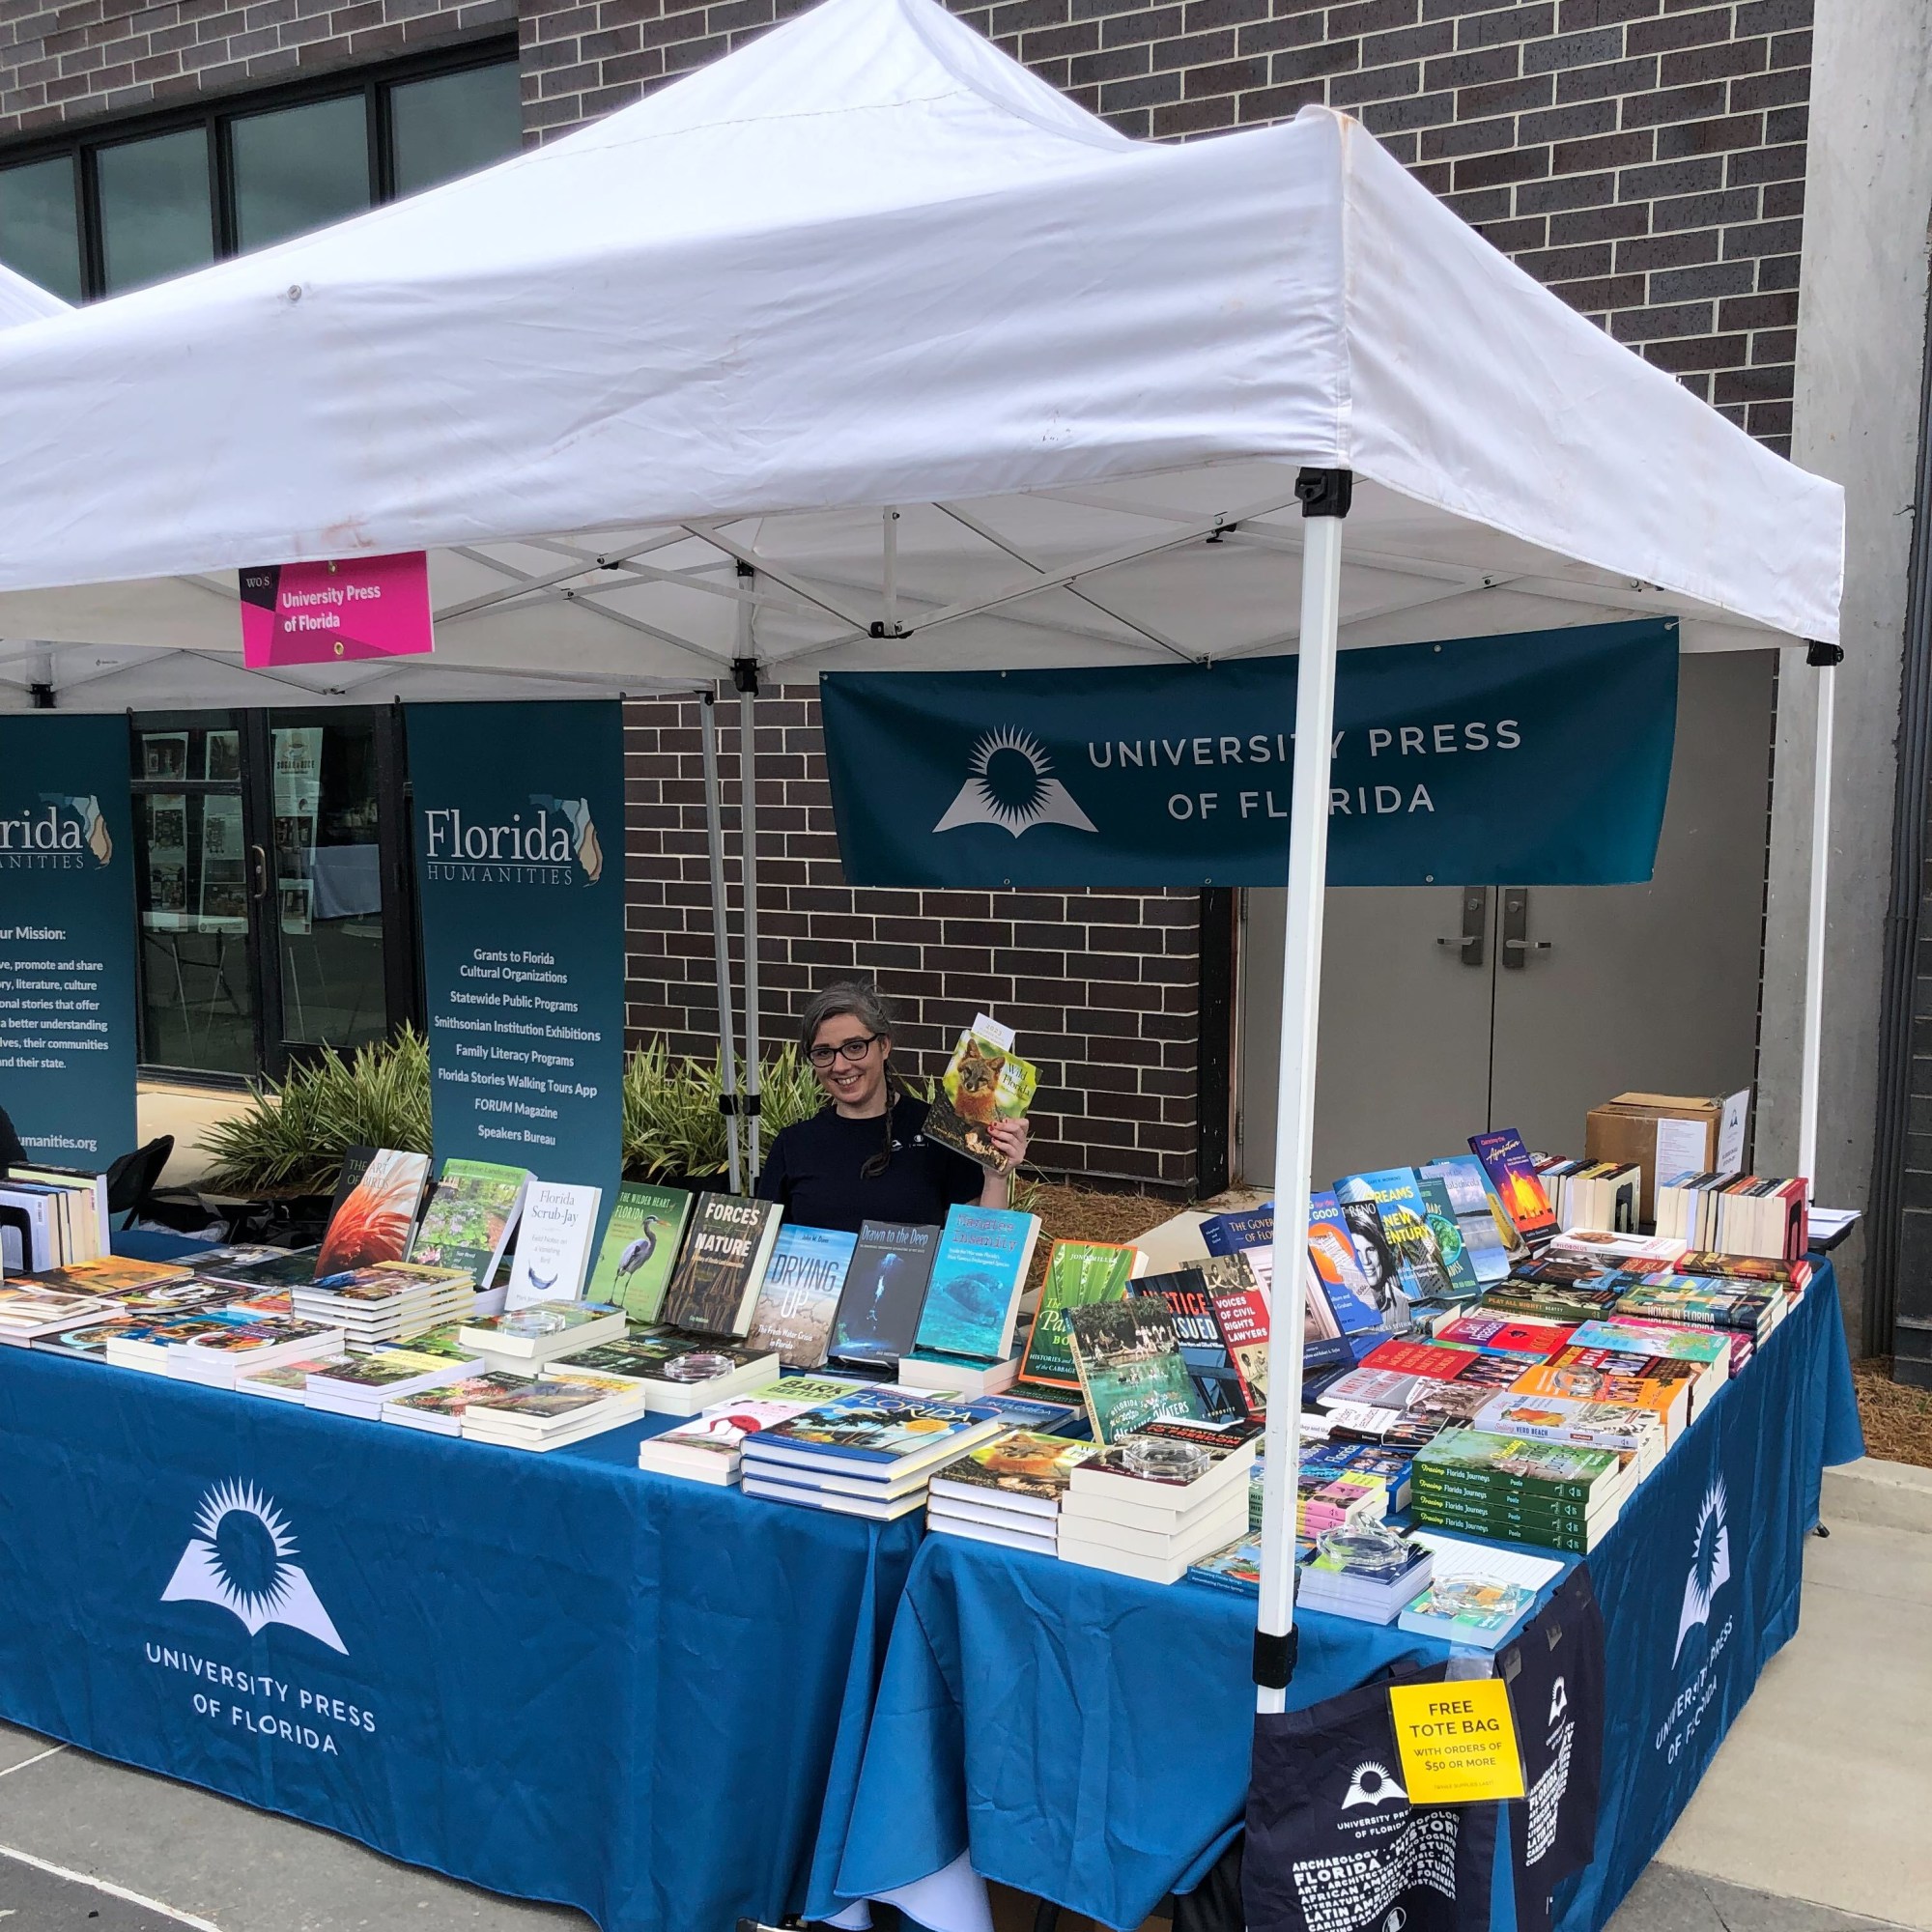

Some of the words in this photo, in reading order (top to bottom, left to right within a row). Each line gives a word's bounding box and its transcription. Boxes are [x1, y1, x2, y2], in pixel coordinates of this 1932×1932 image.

[282, 588, 344, 609] University
[347, 585, 382, 601] Press
[284, 619, 298, 633] of
[299, 611, 341, 631] Florida
[1088, 730, 1346, 769] UNIVERSIY
[1369, 719, 1521, 756] PRESS
[1168, 793, 1218, 819] OF
[1239, 783, 1435, 819] FLRIDA
[425, 809, 572, 861] Florida
[428, 865, 573, 886] HUMANITIES
[15, 925, 67, 940] Mission:
[14, 961, 56, 972] promote
[58, 960, 74, 970] and
[76, 960, 103, 971] share
[473, 949, 508, 962] Grants
[510, 951, 522, 963] to
[523, 952, 554, 965] Florida
[461, 965, 500, 980] Cultural
[502, 967, 568, 983] Organizations
[15, 979, 63, 991] literature,
[64, 980, 98, 990] culture
[21, 999, 53, 1009] stories
[55, 999, 74, 1009] that
[75, 1000, 100, 1010] offer
[450, 991, 500, 1006] Statewide
[502, 994, 533, 1009] Public
[534, 998, 579, 1012] Programs
[0, 1019, 6, 1028] a
[9, 1018, 39, 1029] better
[41, 1019, 108, 1032] understanding
[435, 1015, 492, 1032] Smithsonian
[494, 1020, 545, 1037] Institution
[546, 1027, 601, 1042] Exhibitions
[23, 1037, 46, 1048] their
[47, 1039, 109, 1050] communities
[16, 1057, 39, 1067] their
[41, 1058, 67, 1068] state.
[456, 1044, 489, 1061] Family
[491, 1046, 530, 1064] Literacy
[531, 1051, 575, 1067] Programs
[1007, 1062, 1029, 1081] Wild
[438, 1068, 469, 1083] Florida
[470, 1071, 505, 1087] Stories
[506, 1075, 547, 1093] Walking
[548, 1080, 573, 1094] Tours
[574, 1083, 598, 1099] App
[1002, 1074, 1031, 1096] Florida
[474, 1097, 513, 1112] FORUM
[514, 1102, 558, 1120] Magazine
[477, 1124, 523, 1141] Speakers
[524, 1131, 556, 1147] Bureau
[349, 1159, 367, 1172] THE
[368, 1161, 389, 1174] ART
[347, 1174, 360, 1185] OF
[362, 1177, 390, 1190] BIRDS
[539, 1190, 575, 1206] Florida
[619, 1192, 631, 1203] THE
[631, 1193, 652, 1207] WILDER
[652, 1196, 671, 1208] HEART
[531, 1206, 579, 1227] Scrub-Jay
[614, 1205, 644, 1221] FLORIDA
[705, 1202, 760, 1226] FORCES
[1312, 1208, 1339, 1221] GOOD
[1350, 1203, 1377, 1217] RENO
[957, 1214, 1015, 1232] Manatee
[1229, 1221, 1247, 1233] THE
[1383, 1212, 1411, 1227] NEW
[862, 1225, 886, 1242] Drawn
[887, 1228, 895, 1242] to
[896, 1228, 908, 1243] the
[909, 1229, 929, 1246] Deep
[952, 1230, 1018, 1253] Insanity
[1245, 1233, 1257, 1242] OF
[695, 1233, 753, 1257] NATURE
[1556, 1242, 1587, 1252] PILOBOLUS
[771, 1254, 839, 1293] DRYING
[781, 1290, 810, 1319] UP
[1046, 1297, 1062, 1309] The
[1216, 1295, 1247, 1309] VOICES
[1489, 1297, 1505, 1306] PLAY
[1519, 1301, 1543, 1311] NIGHT!
[1220, 1310, 1232, 1321] OF
[1233, 1308, 1256, 1319] CIVIL
[1647, 1305, 1671, 1319] HOME
[1672, 1308, 1681, 1320] IN
[1683, 1310, 1716, 1323] FLORIDA
[768, 1325, 782, 1336] Fresh
[782, 1328, 798, 1339] Water
[798, 1331, 813, 1342] Crisis
[1224, 1318, 1255, 1332] RIGHTS
[1228, 1327, 1268, 1343] LAWYERS
[776, 1340, 793, 1350] Florida
[1029, 1353, 1062, 1364] HISTORIES
[766, 1386, 837, 1399] BEETLES
[779, 1379, 852, 1395] BARK
[842, 1393, 973, 1422] FLORIDA
[999, 1403, 1052, 1415] FLORIDA
[1153, 1401, 1190, 1420] WATERS
[1170, 1429, 1240, 1445] FREEDOM
[1219, 1432, 1245, 1441] ROW
[1516, 1426, 1529, 1435] VERO
[1531, 1428, 1548, 1436] BEACH
[1421, 1463, 1445, 1475] Tracing
[1446, 1469, 1465, 1479] Florida
[1465, 1470, 1491, 1483] Journeys
[1419, 1479, 1442, 1492] Tracing
[1443, 1484, 1463, 1494] Florida
[1463, 1487, 1488, 1499] Journeys
[1420, 1496, 1443, 1508] Tracing
[1444, 1500, 1463, 1511] Florida
[1463, 1503, 1489, 1516] Journeys
[1420, 1512, 1443, 1524] Tracing
[1445, 1518, 1464, 1527] Florida
[1464, 1520, 1489, 1533] Journeys
[146, 1642, 289, 1702] UNIVERSITY
[299, 1689, 376, 1732] PRESS
[1429, 1700, 1474, 1716] FREE
[193, 1693, 221, 1718] OF
[232, 1706, 338, 1756] FLORIDA
[1409, 1721, 1458, 1738] TOTE
[1462, 1718, 1500, 1734] BAG
[1414, 1747, 1442, 1757] WITH
[1444, 1743, 1486, 1755] ORDERS
[1489, 1742, 1502, 1750] OF
[1667, 1733, 1682, 1765] OF
[1425, 1760, 1446, 1772] $50
[1448, 1760, 1463, 1769] OR
[1465, 1757, 1496, 1768] MORE
[1337, 1814, 1391, 1831] UNIVERSITY
[1354, 1830, 1368, 1839] OF
[1370, 1820, 1406, 1836] FLORIDA
[1292, 1848, 1380, 1873] ARCHAEOLOGY
[1293, 1857, 1382, 1888] FLORIDA
[1395, 1819, 1460, 1858] HISTORY
[1297, 1885, 1319, 1896] ART
[1327, 1856, 1400, 1890] ARCHITECTURE
[1300, 1885, 1359, 1906] AFRICAN
[1363, 1846, 1416, 1892] AMERICAN
[1302, 1892, 1366, 1914] LITERATURE
[1406, 1851, 1435, 1868] MUSIC
[1304, 1906, 1350, 1924] LATIN
[1353, 1866, 1413, 1915] AMERICAN
[1360, 1889, 1402, 1927] GARDENING
[1307, 1909, 1373, 1932] CARIBBEAN
